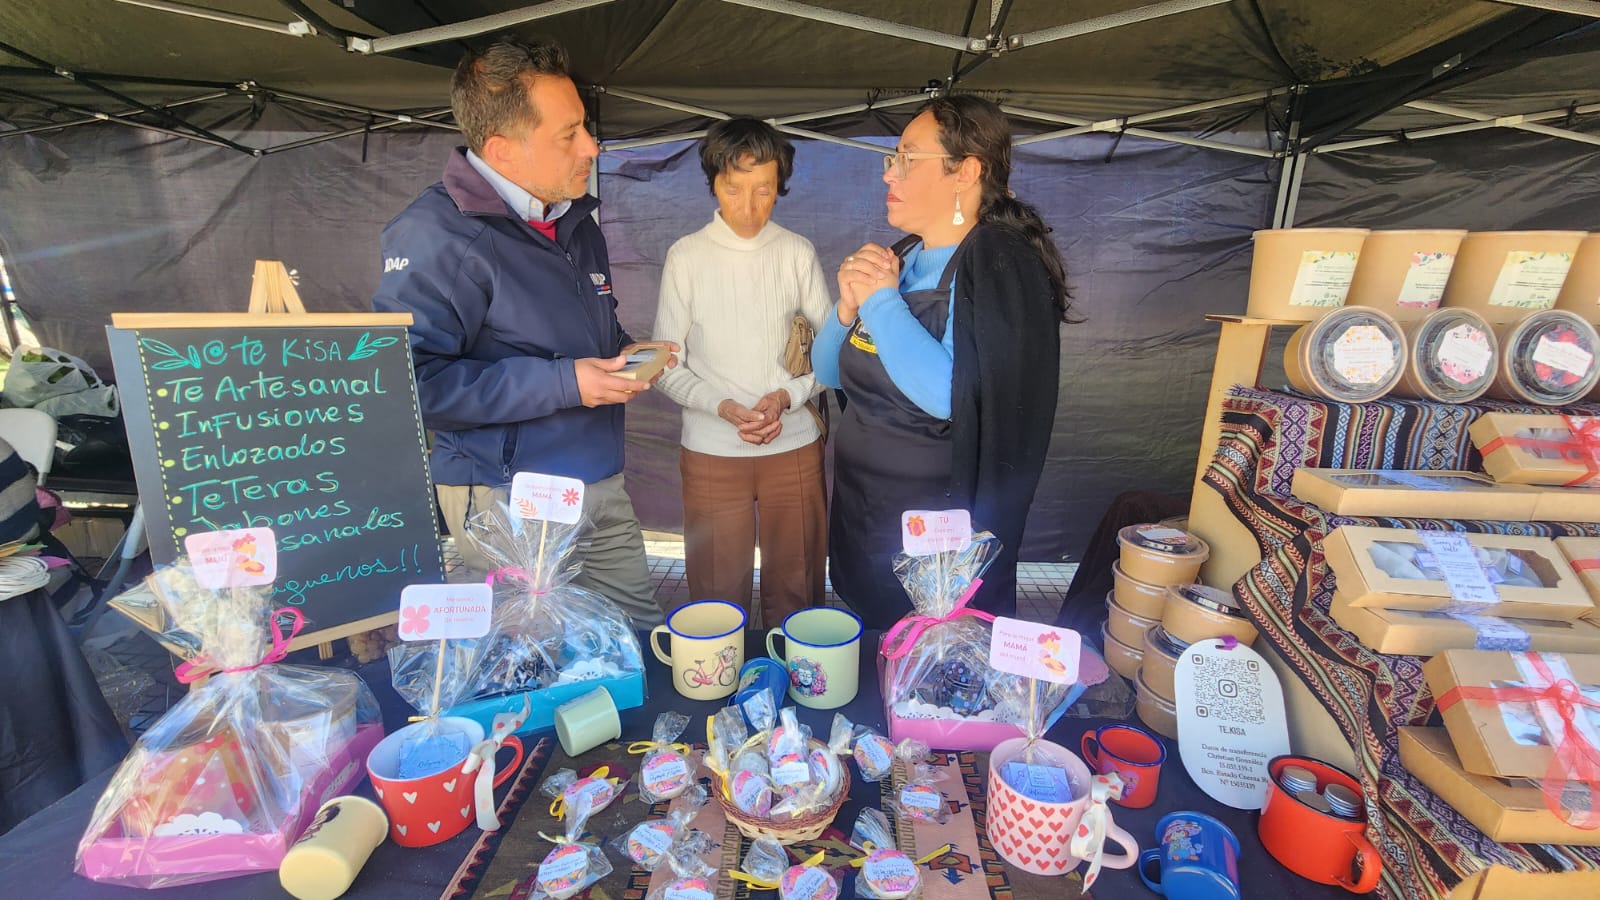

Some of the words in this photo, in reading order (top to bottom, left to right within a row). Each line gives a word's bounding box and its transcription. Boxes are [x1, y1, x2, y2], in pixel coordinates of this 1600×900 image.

[165, 376, 204, 404] Te
[215, 368, 387, 401] Artesanal
[182, 433, 346, 471] Enlozados
[433, 605, 486, 614] AFORTUNADA
[1228, 748, 1267, 758] transferencia
